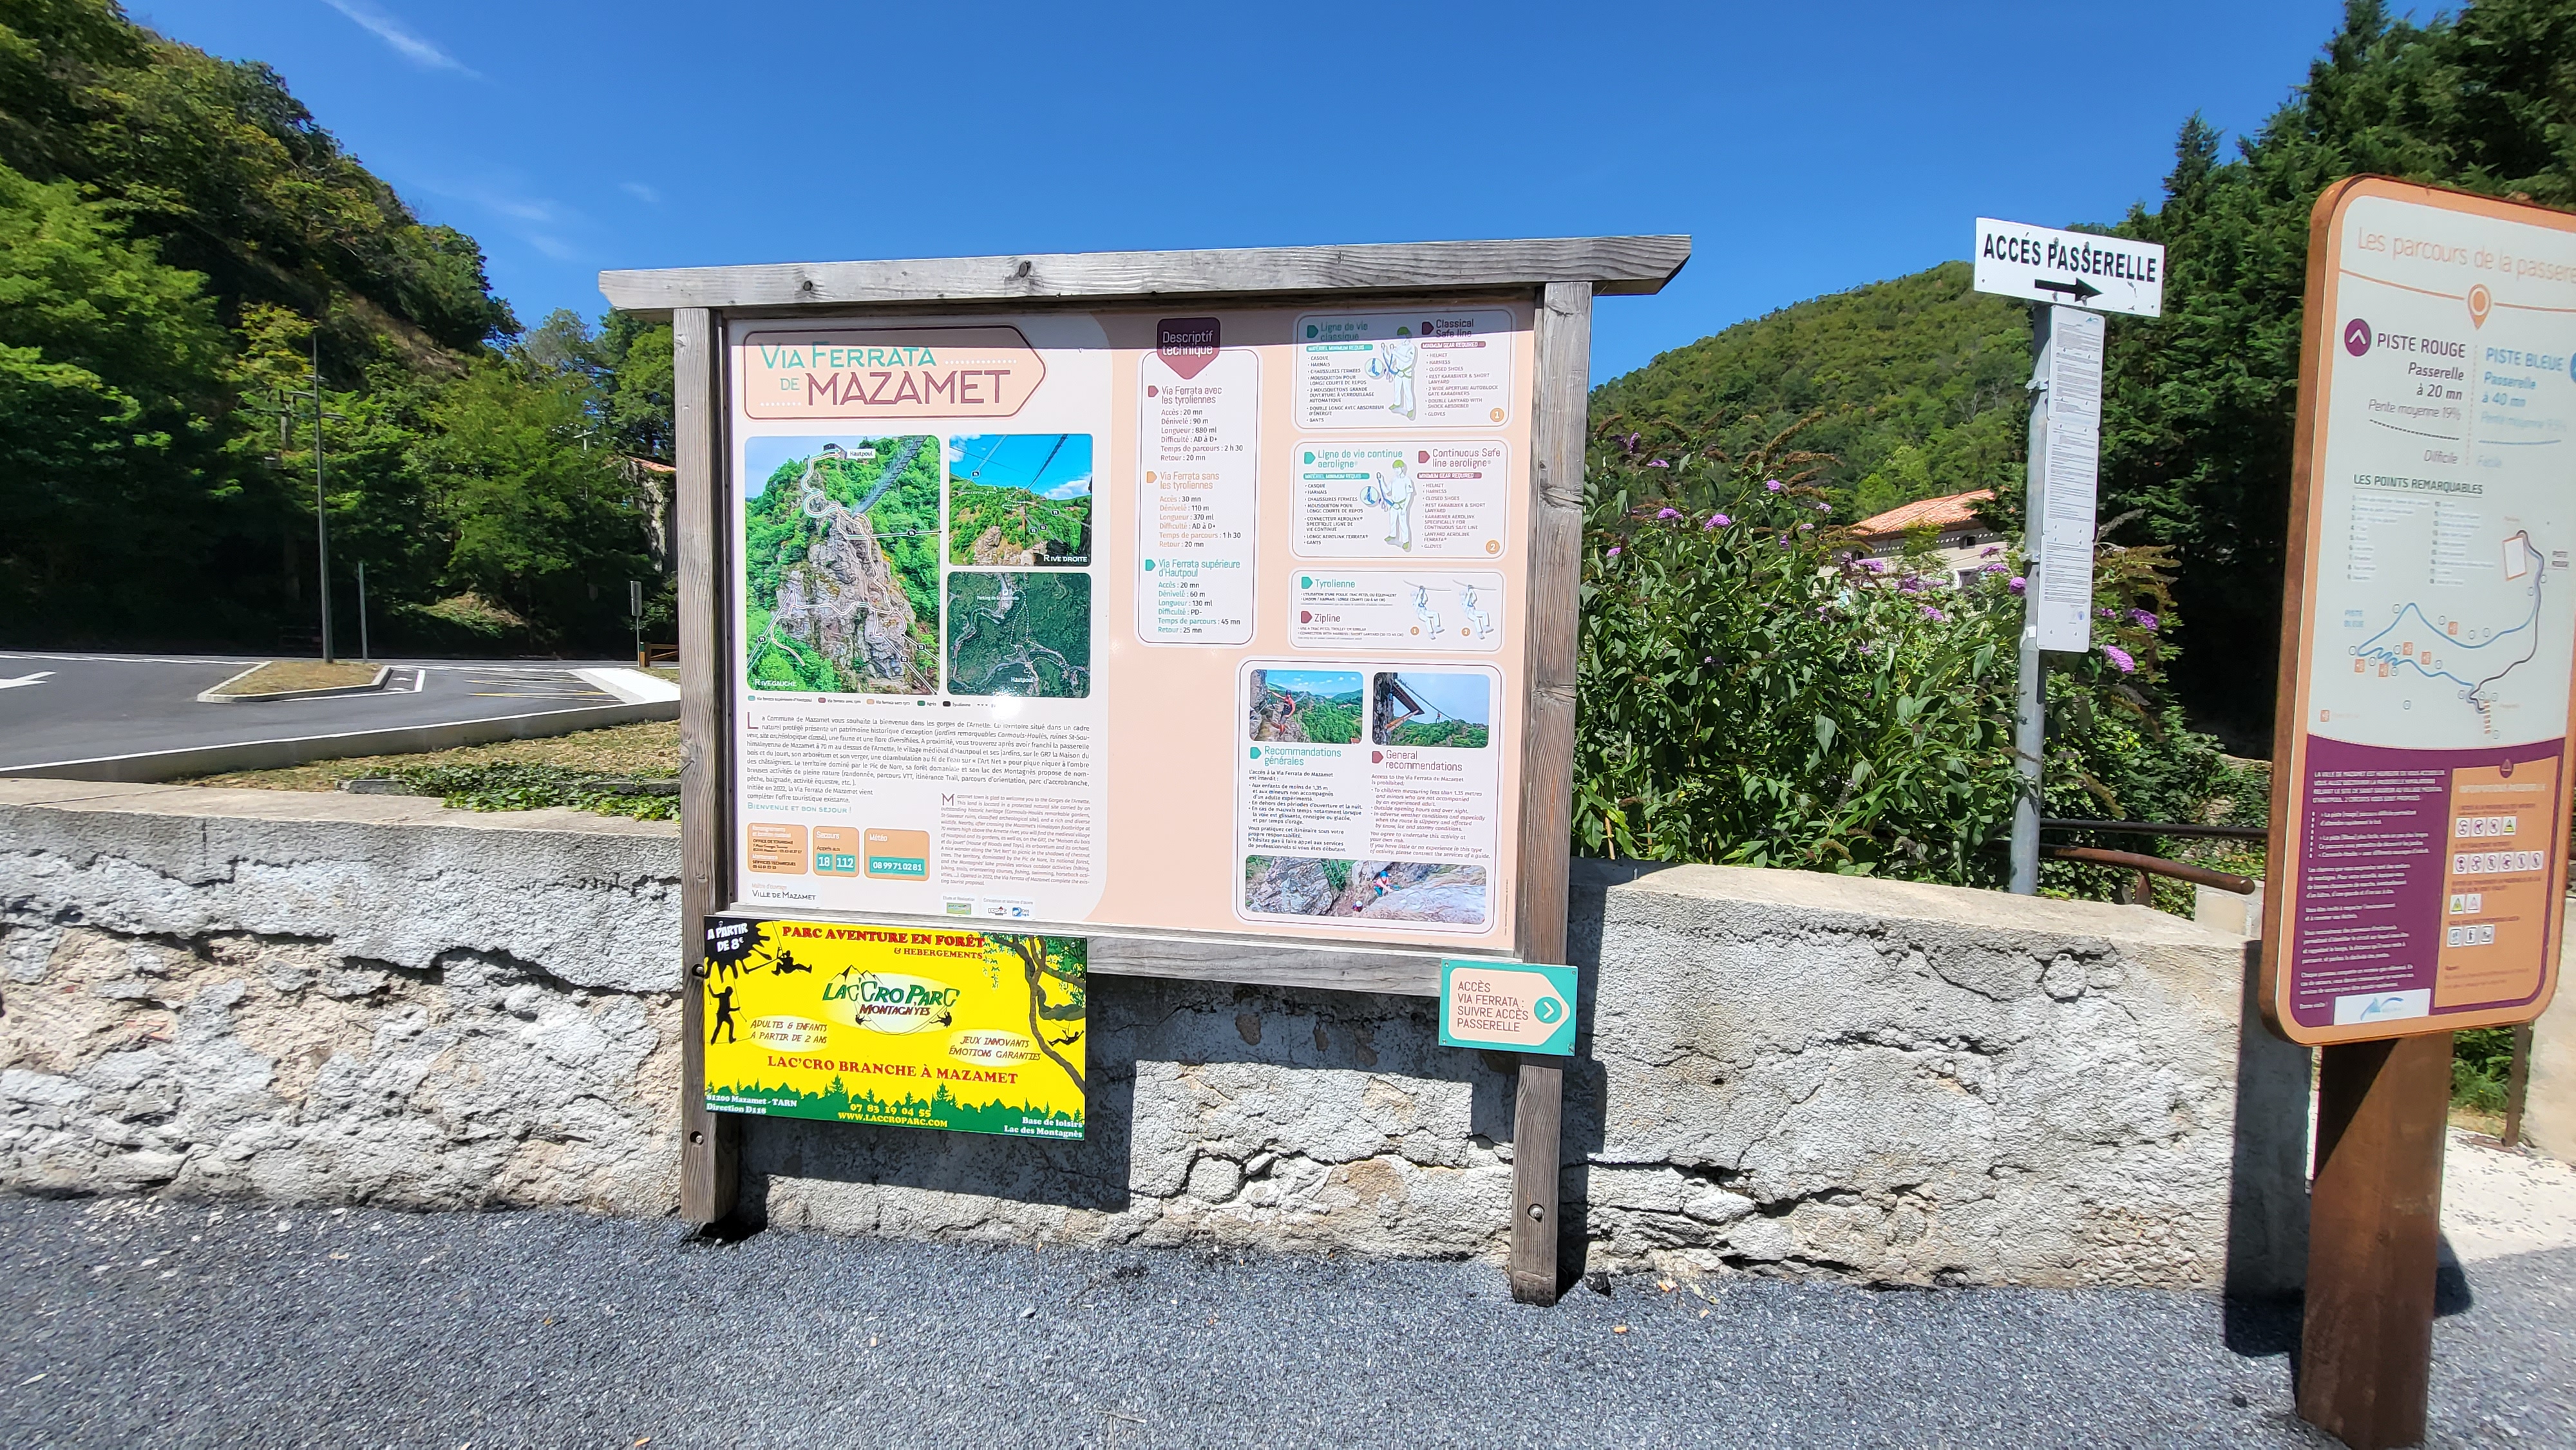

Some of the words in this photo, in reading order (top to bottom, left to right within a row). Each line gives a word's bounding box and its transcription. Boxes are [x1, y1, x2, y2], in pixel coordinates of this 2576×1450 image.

[2358, 226, 2386, 252] Les
[2393, 237, 2468, 266] parcours
[2474, 245, 2494, 269] de
[2499, 249, 2512, 272] la
[1983, 232, 2041, 266] ACCÉS
[2047, 243, 2156, 282] PASSERELLE
[1321, 323, 1341, 332] Ligne
[1436, 319, 1473, 328] Classical
[1163, 331, 1213, 344] Descriptif
[1321, 332, 1359, 342] classique
[1436, 329, 1455, 337] Safe
[1162, 344, 1213, 358] technique
[2377, 333, 2416, 351] PISTE
[2421, 339, 2466, 358] ROUGE
[2486, 347, 2521, 365] PISTE
[2525, 353, 2564, 371] BLEUE
[2408, 362, 2464, 381] Passerelle
[780, 378, 800, 391] DE
[806, 370, 1011, 406] MAZAMET
[1162, 386, 1173, 395] Via
[1175, 386, 1202, 395] Ferrata
[2416, 383, 2423, 395] à
[2427, 384, 2443, 398] 20
[2446, 389, 2462, 400] mn
[1162, 395, 1173, 404] les
[1175, 395, 1216, 406] tyroliennes
[1318, 450, 1339, 460] Ligne
[1367, 449, 1403, 458] continue
[1432, 449, 1479, 457] Continuous
[1482, 448, 1501, 457] Safe
[2424, 449, 2458, 464] Difficile
[1432, 458, 1446, 467] line
[1160, 472, 1171, 480] Via
[1173, 472, 1200, 480] Ferrata
[1160, 481, 1171, 489] les
[1173, 481, 1213, 491] tyroliennes
[2354, 474, 2371, 485] LES
[2374, 475, 2409, 488] POINTS
[2412, 478, 2483, 494] REMARQUABLES
[1159, 560, 1170, 568] Via
[1172, 560, 1199, 568] Ferrata
[1202, 560, 1240, 569] supérieure
[1159, 569, 1198, 579] d'Hautpoul
[1315, 579, 1355, 590] Tyrolienne
[1314, 614, 1340, 624] Zipline
[1265, 746, 1341, 757] Recommandations
[1386, 749, 1417, 760] General
[1265, 757, 1304, 766] générales
[1386, 761, 1463, 771] recommendations
[819, 856, 830, 866] 18
[837, 858, 853, 868] 112
[782, 892, 816, 900] MAZAMET
[707, 929, 714, 940] A
[716, 923, 748, 937] PARTIR
[782, 926, 822, 938] PARC
[826, 929, 908, 943] AVENTURE
[912, 934, 932, 945] EN
[936, 933, 985, 948] FORÊT
[717, 940, 730, 952] DE
[731, 937, 744, 950] 8€
[904, 948, 983, 959] HEBERGEMENTS
[1457, 980, 1491, 992] ACCÈS
[1457, 993, 1472, 1004] VIA
[1476, 995, 1519, 1007] FERRATA
[1457, 1006, 1493, 1017] SUIVRE
[1495, 1008, 1529, 1020] ACCÈS
[750, 1020, 784, 1029] ADULTES
[796, 1023, 827, 1031] ENFANTS
[1457, 1018, 1520, 1031] PASSERELLE
[984, 1037, 1029, 1048] INNOVANTS
[949, 1046, 992, 1057] ÉMOTIONS
[996, 1051, 1041, 1060] GARANTIES
[838, 1060, 916, 1077] BRANCHE
[920, 1064, 932, 1078] À
[936, 1068, 1019, 1084] MAZAMET
[732, 1096, 766, 1105] Mazamet
[772, 1098, 797, 1107] TARN
[706, 1103, 744, 1113] Direction
[867, 1104, 880, 1113] 83
[884, 1107, 897, 1115] 19
[901, 1107, 914, 1116] 04
[918, 1109, 931, 1118] 55
[838, 1112, 948, 1127] WWW.LACCROPARC.COM
[1023, 1116, 1042, 1125] Base
[1056, 1119, 1083, 1128] loisirs
[1037, 1127, 1083, 1138] Montagnès
